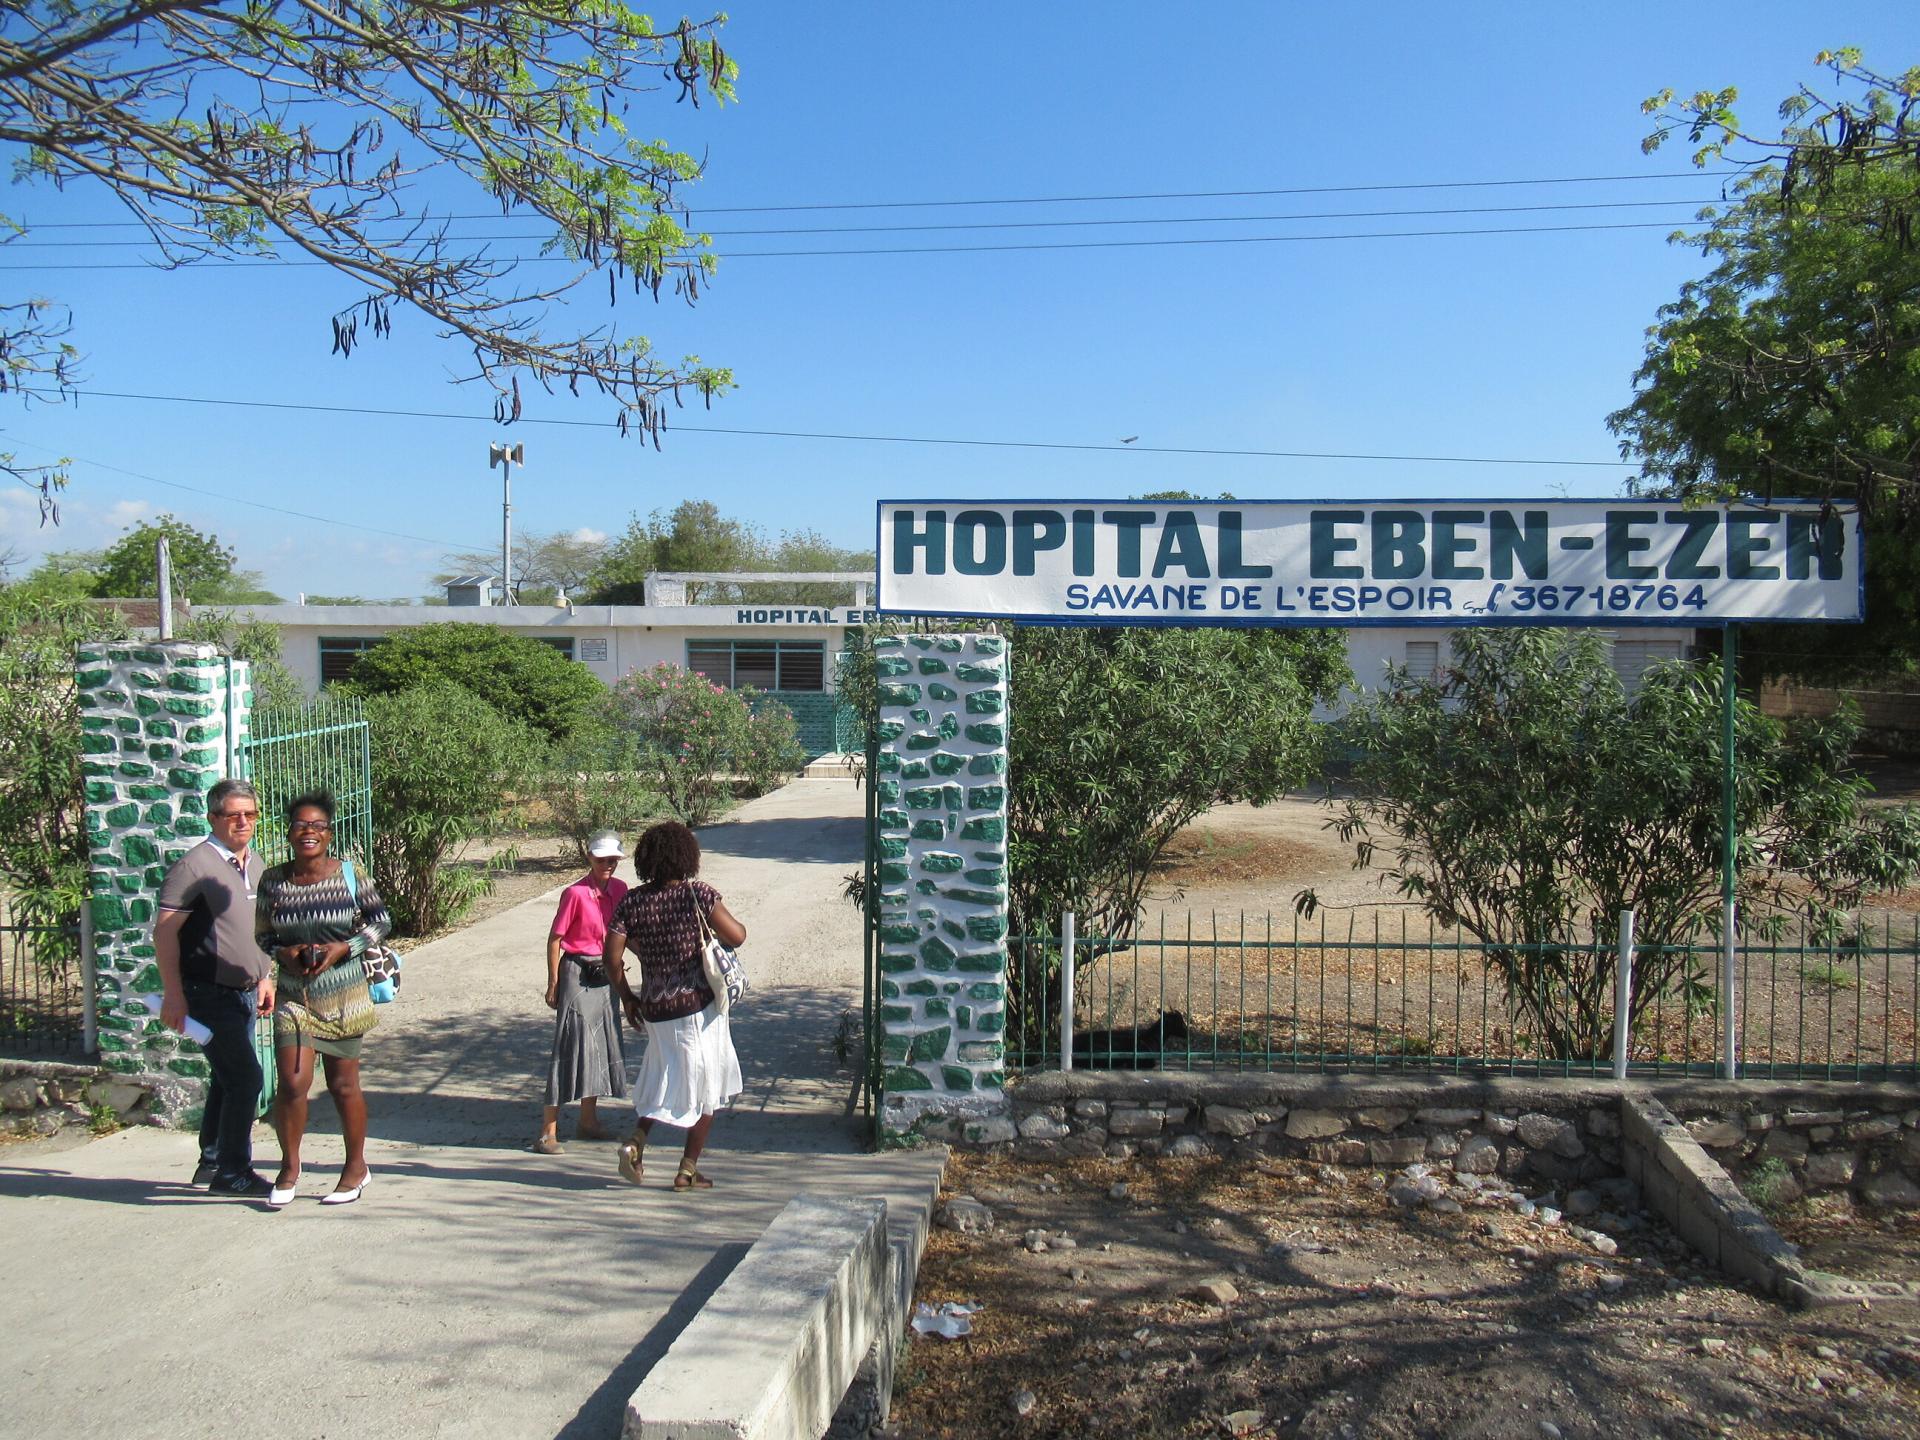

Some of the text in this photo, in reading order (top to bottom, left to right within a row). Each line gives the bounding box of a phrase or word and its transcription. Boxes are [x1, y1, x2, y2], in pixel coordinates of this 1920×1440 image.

[893, 509, 1844, 581] HOPITAL EBEN-EZER
[1065, 584, 1207, 610] SAVANE
[1220, 585, 1262, 610] DE
[1276, 585, 1453, 611] L'ESPOIR
[737, 609, 839, 624] HOPITAL
